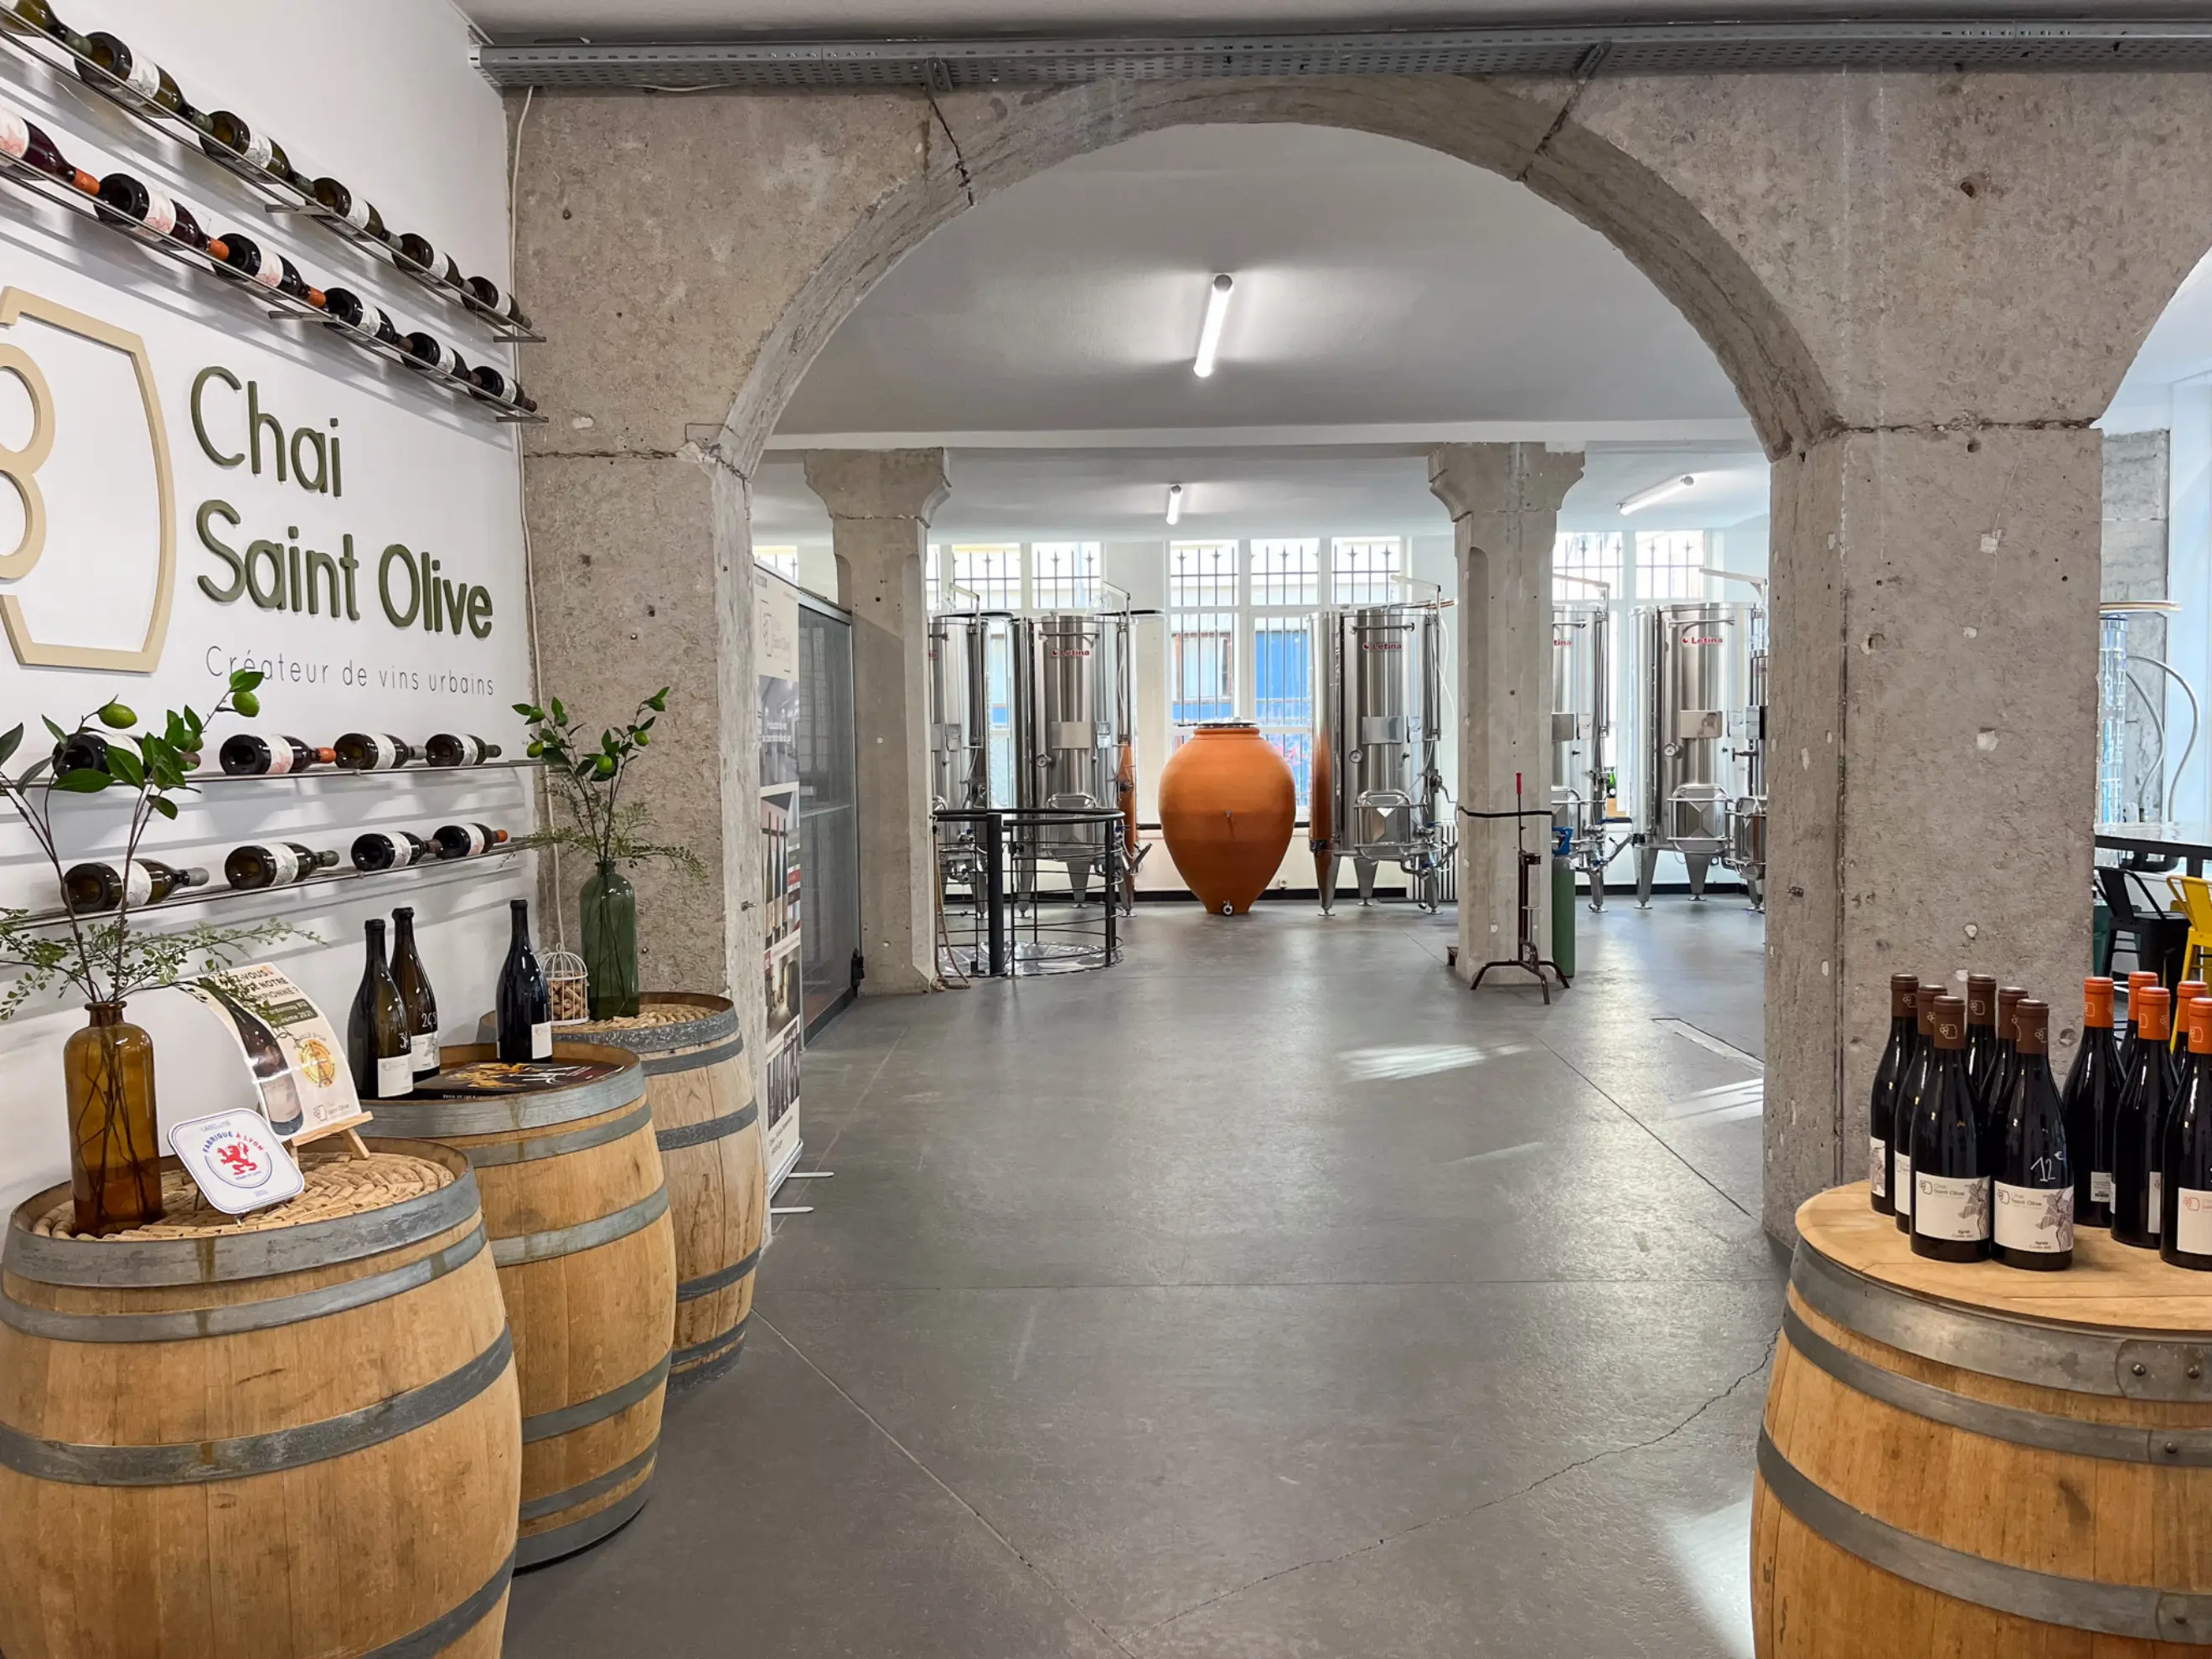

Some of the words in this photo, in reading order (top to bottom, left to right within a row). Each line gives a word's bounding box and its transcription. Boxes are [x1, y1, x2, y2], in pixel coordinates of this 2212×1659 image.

[191, 365, 342, 498] Chai
[196, 499, 360, 621] Saint
[379, 544, 493, 638] Olive
[206, 646, 329, 684] Créateur
[343, 659, 368, 687] de
[380, 664, 420, 690] vins
[428, 669, 494, 696] urbains
[244, 1134, 265, 1152] LYON
